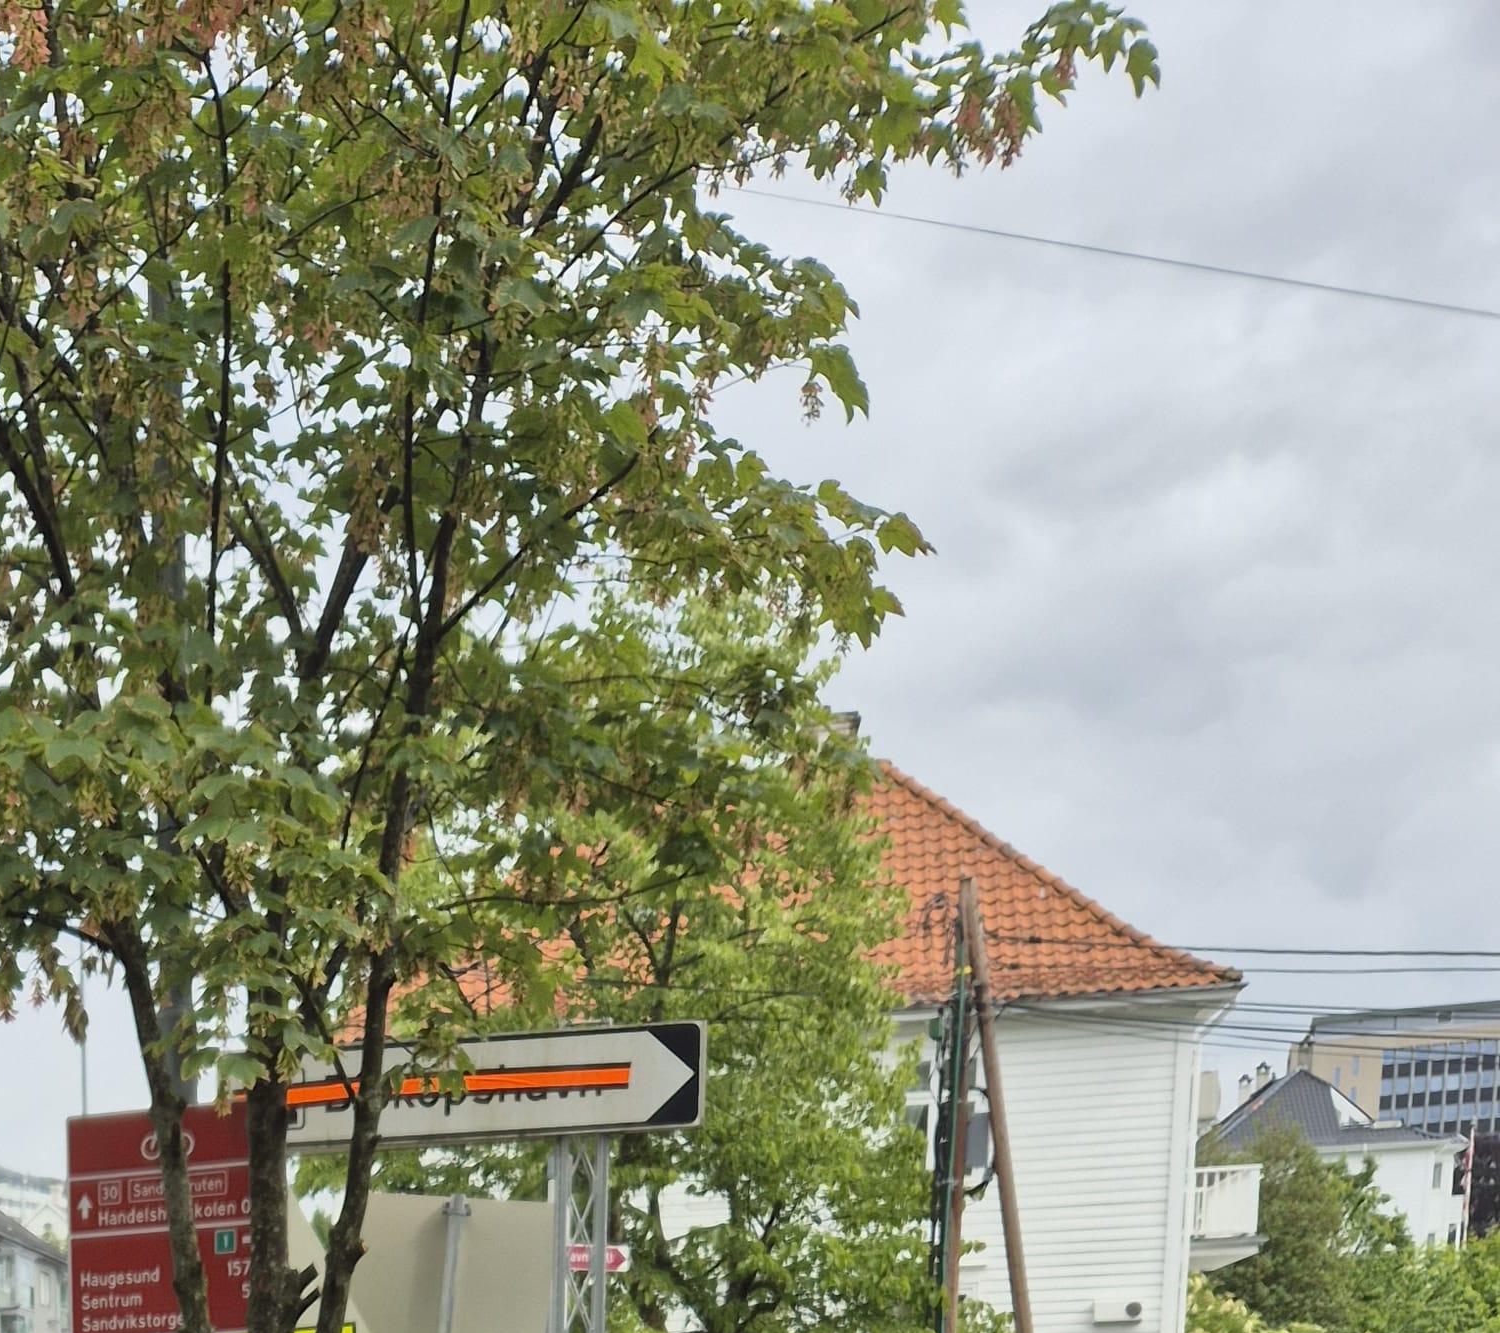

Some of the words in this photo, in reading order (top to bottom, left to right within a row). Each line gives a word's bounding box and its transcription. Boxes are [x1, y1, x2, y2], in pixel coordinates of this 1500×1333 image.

[102, 1186, 118, 1201] 30
[80, 1266, 161, 1289] Haugesund
[81, 1293, 143, 1311] Sentrum
[82, 1313, 184, 1333] Sandvikstorge
